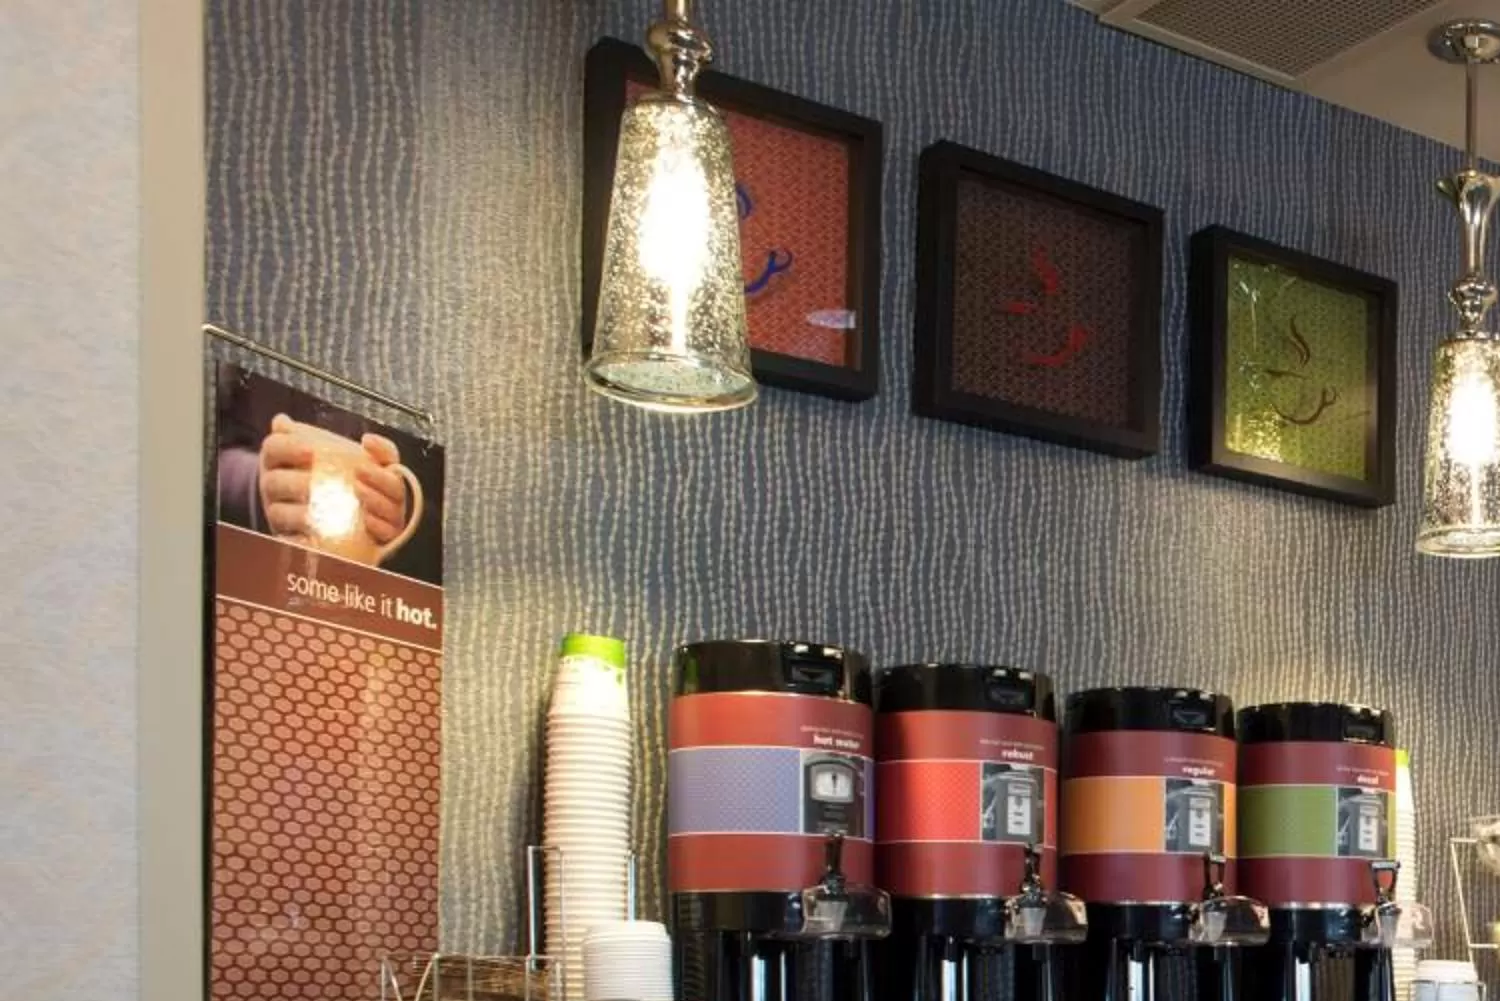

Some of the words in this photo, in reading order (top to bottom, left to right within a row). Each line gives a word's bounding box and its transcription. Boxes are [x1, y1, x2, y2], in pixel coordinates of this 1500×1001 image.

[286, 572, 340, 603] some
[344, 582, 376, 614] like
[380, 593, 393, 620] it
[395, 597, 438, 630] hot.
